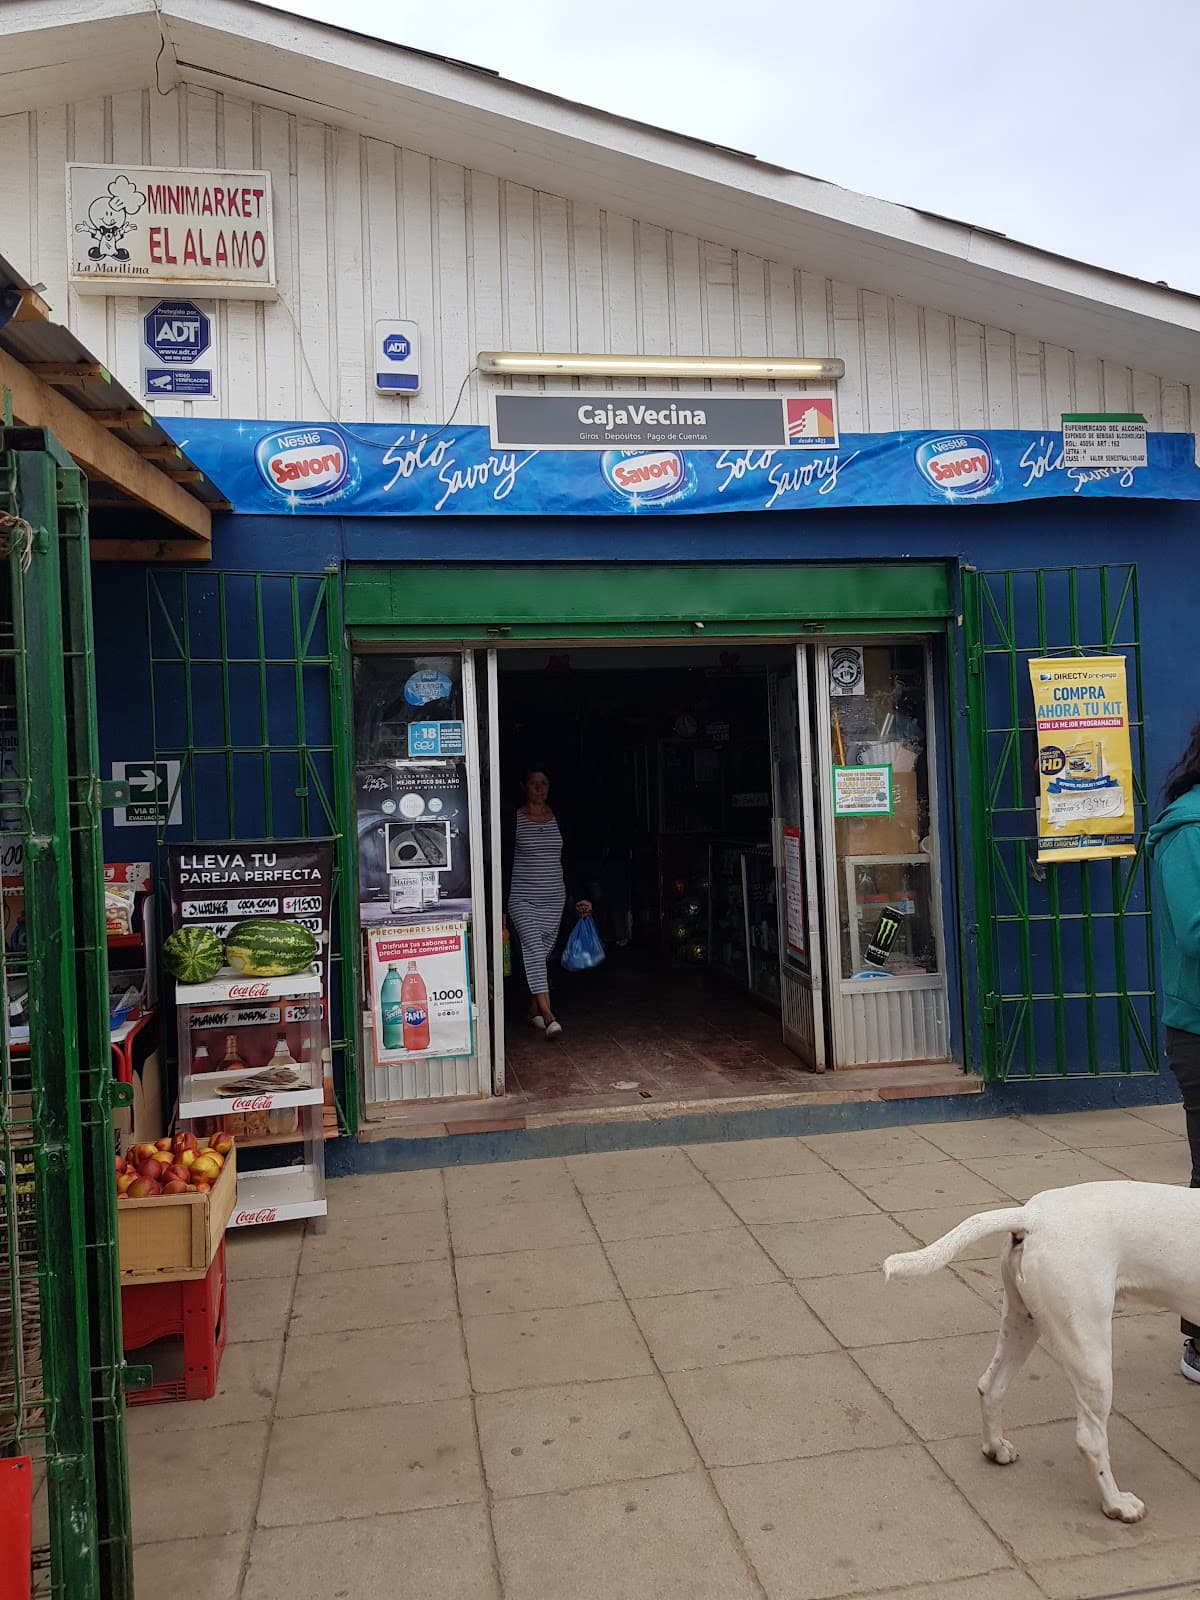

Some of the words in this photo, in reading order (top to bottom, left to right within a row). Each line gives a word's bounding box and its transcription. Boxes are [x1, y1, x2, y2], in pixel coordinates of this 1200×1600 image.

[147, 184, 264, 218] MINIMARKET
[149, 227, 177, 265] EL
[184, 228, 266, 269] ALAMO
[77, 262, 90, 272] La
[156, 321, 199, 343] ADT
[388, 342, 407, 353] ADT
[277, 431, 321, 449] Nestlé
[579, 432, 599, 440] Giros
[605, 432, 641, 441] Depósitos
[647, 433, 665, 441] Pago
[667, 432, 677, 440] de
[678, 432, 708, 440] Cuentas
[932, 436, 968, 453] Nestlé
[271, 451, 341, 484] Savory
[614, 457, 679, 488] Savory
[926, 454, 987, 482] Savory
[435, 450, 540, 511] Savory
[765, 451, 857, 508] Savory
[1054, 672, 1088, 680] DIRECTV
[1053, 686, 1106, 701] COMPRA
[1037, 703, 1081, 719] AHORA
[1083, 702, 1099, 716] TU
[1103, 701, 1122, 715] KIT
[1079, 718, 1121, 727] PROGRAMACIÓN
[1042, 757, 1062, 771] HD
[180, 854, 245, 870] LLEVA
[251, 853, 277, 867] TU
[180, 871, 240, 884] PAREJA
[244, 868, 322, 882] PERFECTA
[370, 928, 403, 937] PRECIO
[406, 923, 464, 934] IRRESISTIBLE
[379, 949, 401, 957] precio
[402, 946, 417, 954] más
[419, 944, 459, 953] conveniente
[382, 942, 409, 950] Disfruta
[422, 939, 448, 947] sabores
